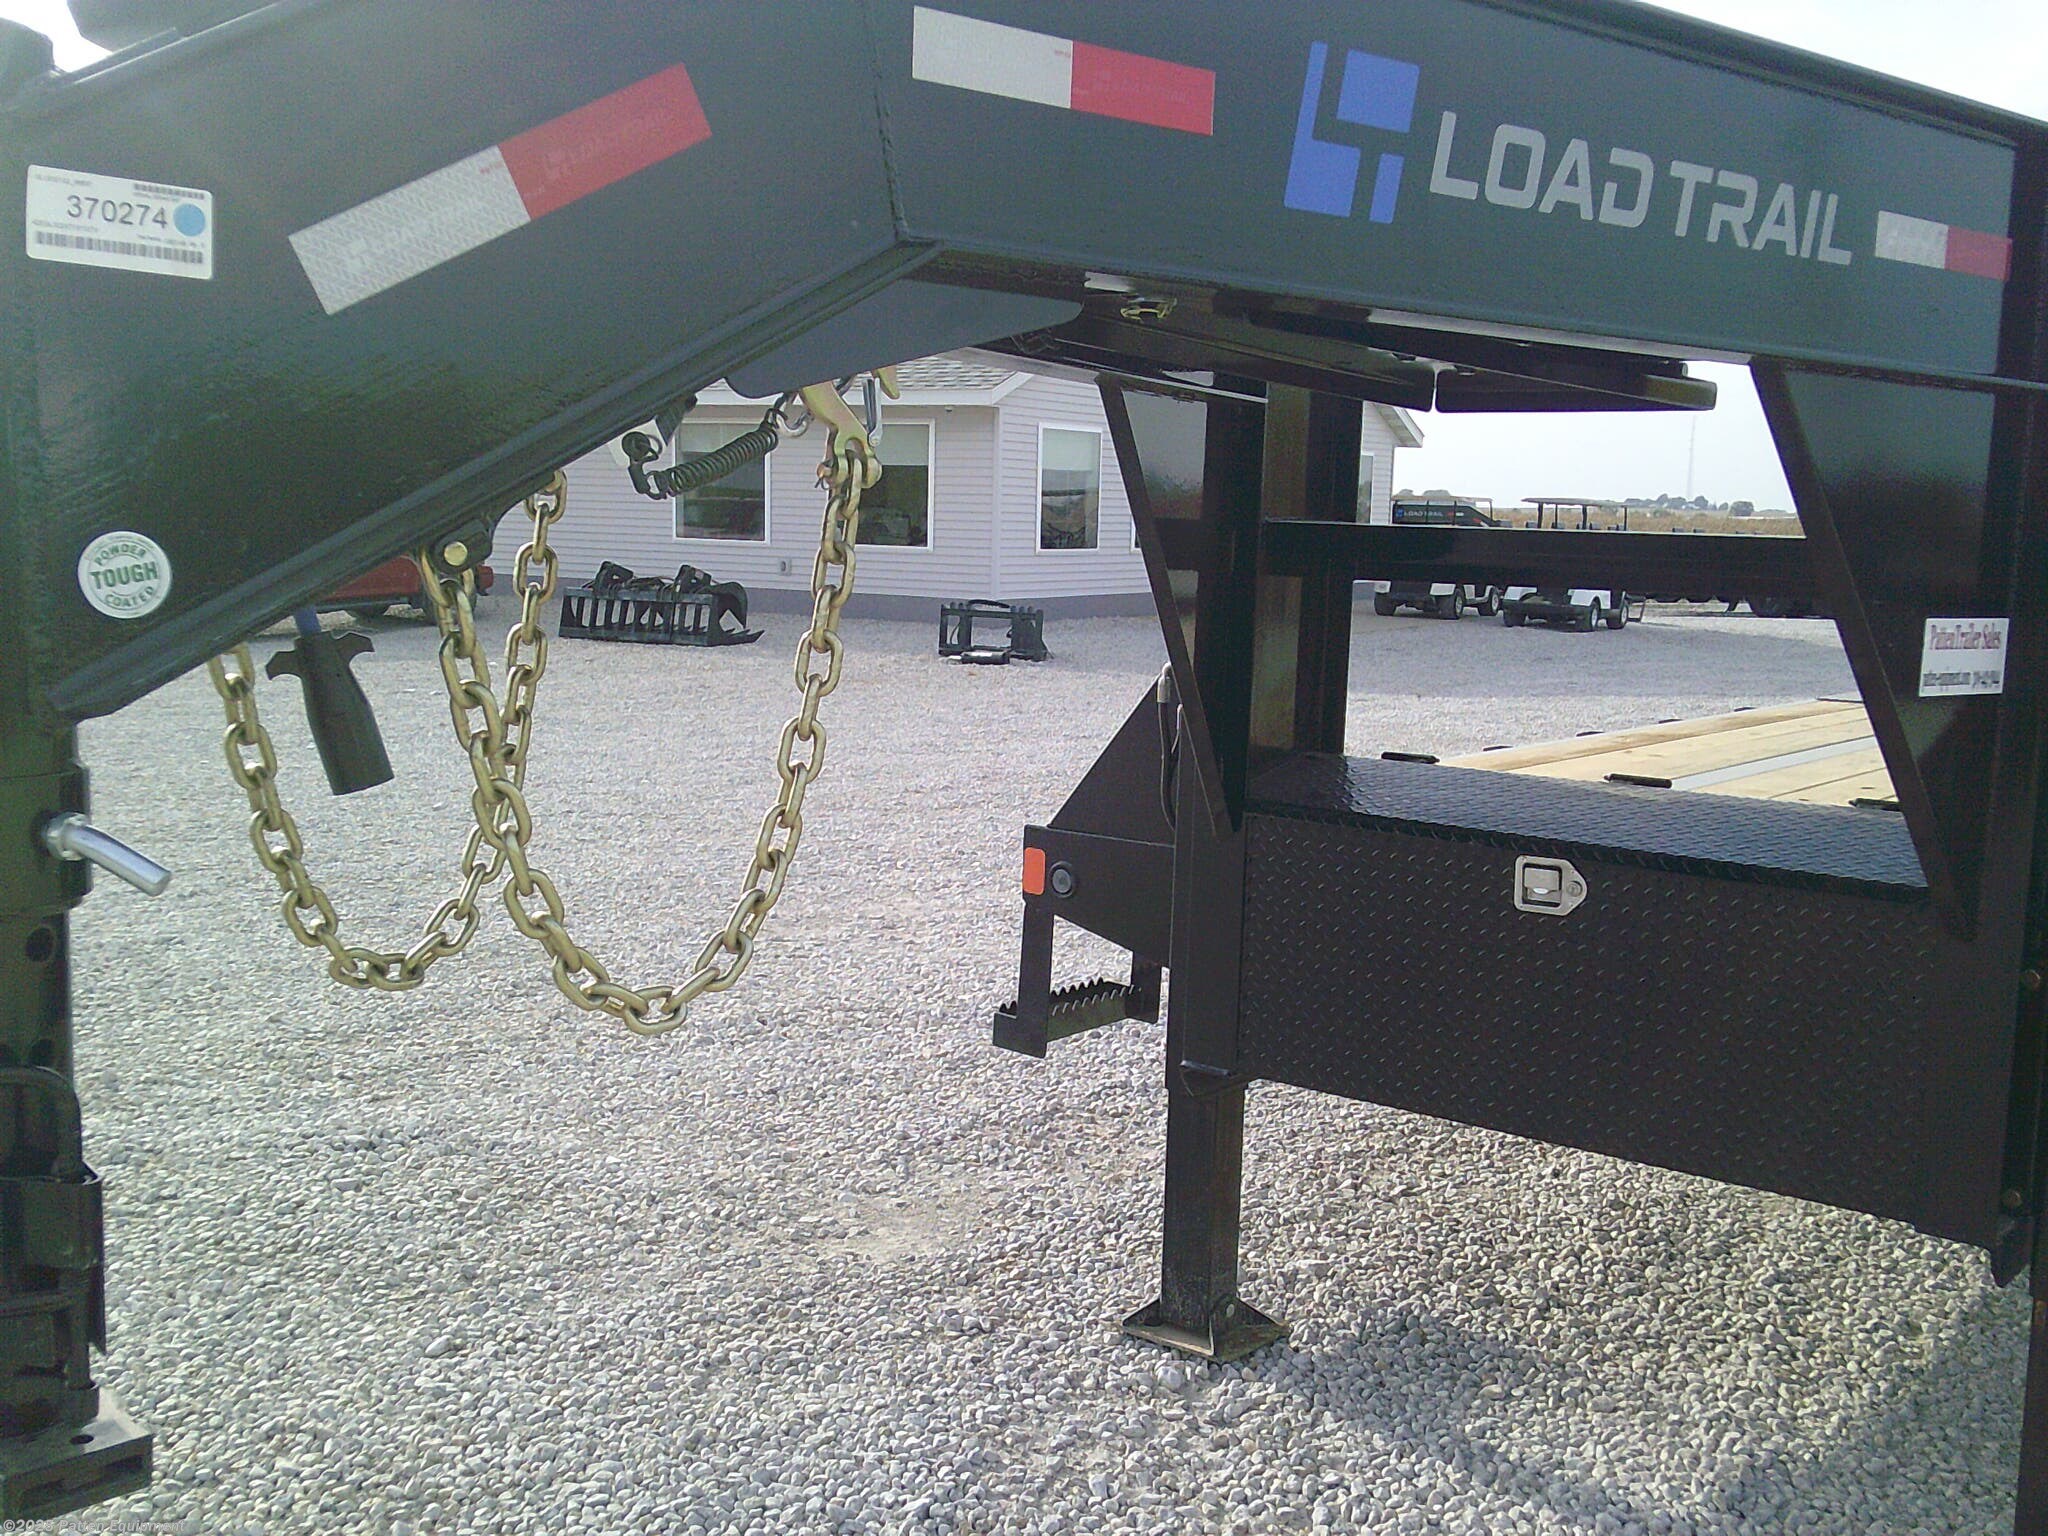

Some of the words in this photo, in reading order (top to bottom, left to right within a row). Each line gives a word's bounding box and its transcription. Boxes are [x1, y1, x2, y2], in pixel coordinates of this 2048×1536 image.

[67, 195, 168, 229] 370274
[94, 543, 146, 566] POWDER
[88, 561, 158, 590] TOUGH
[105, 586, 154, 606] COATED
